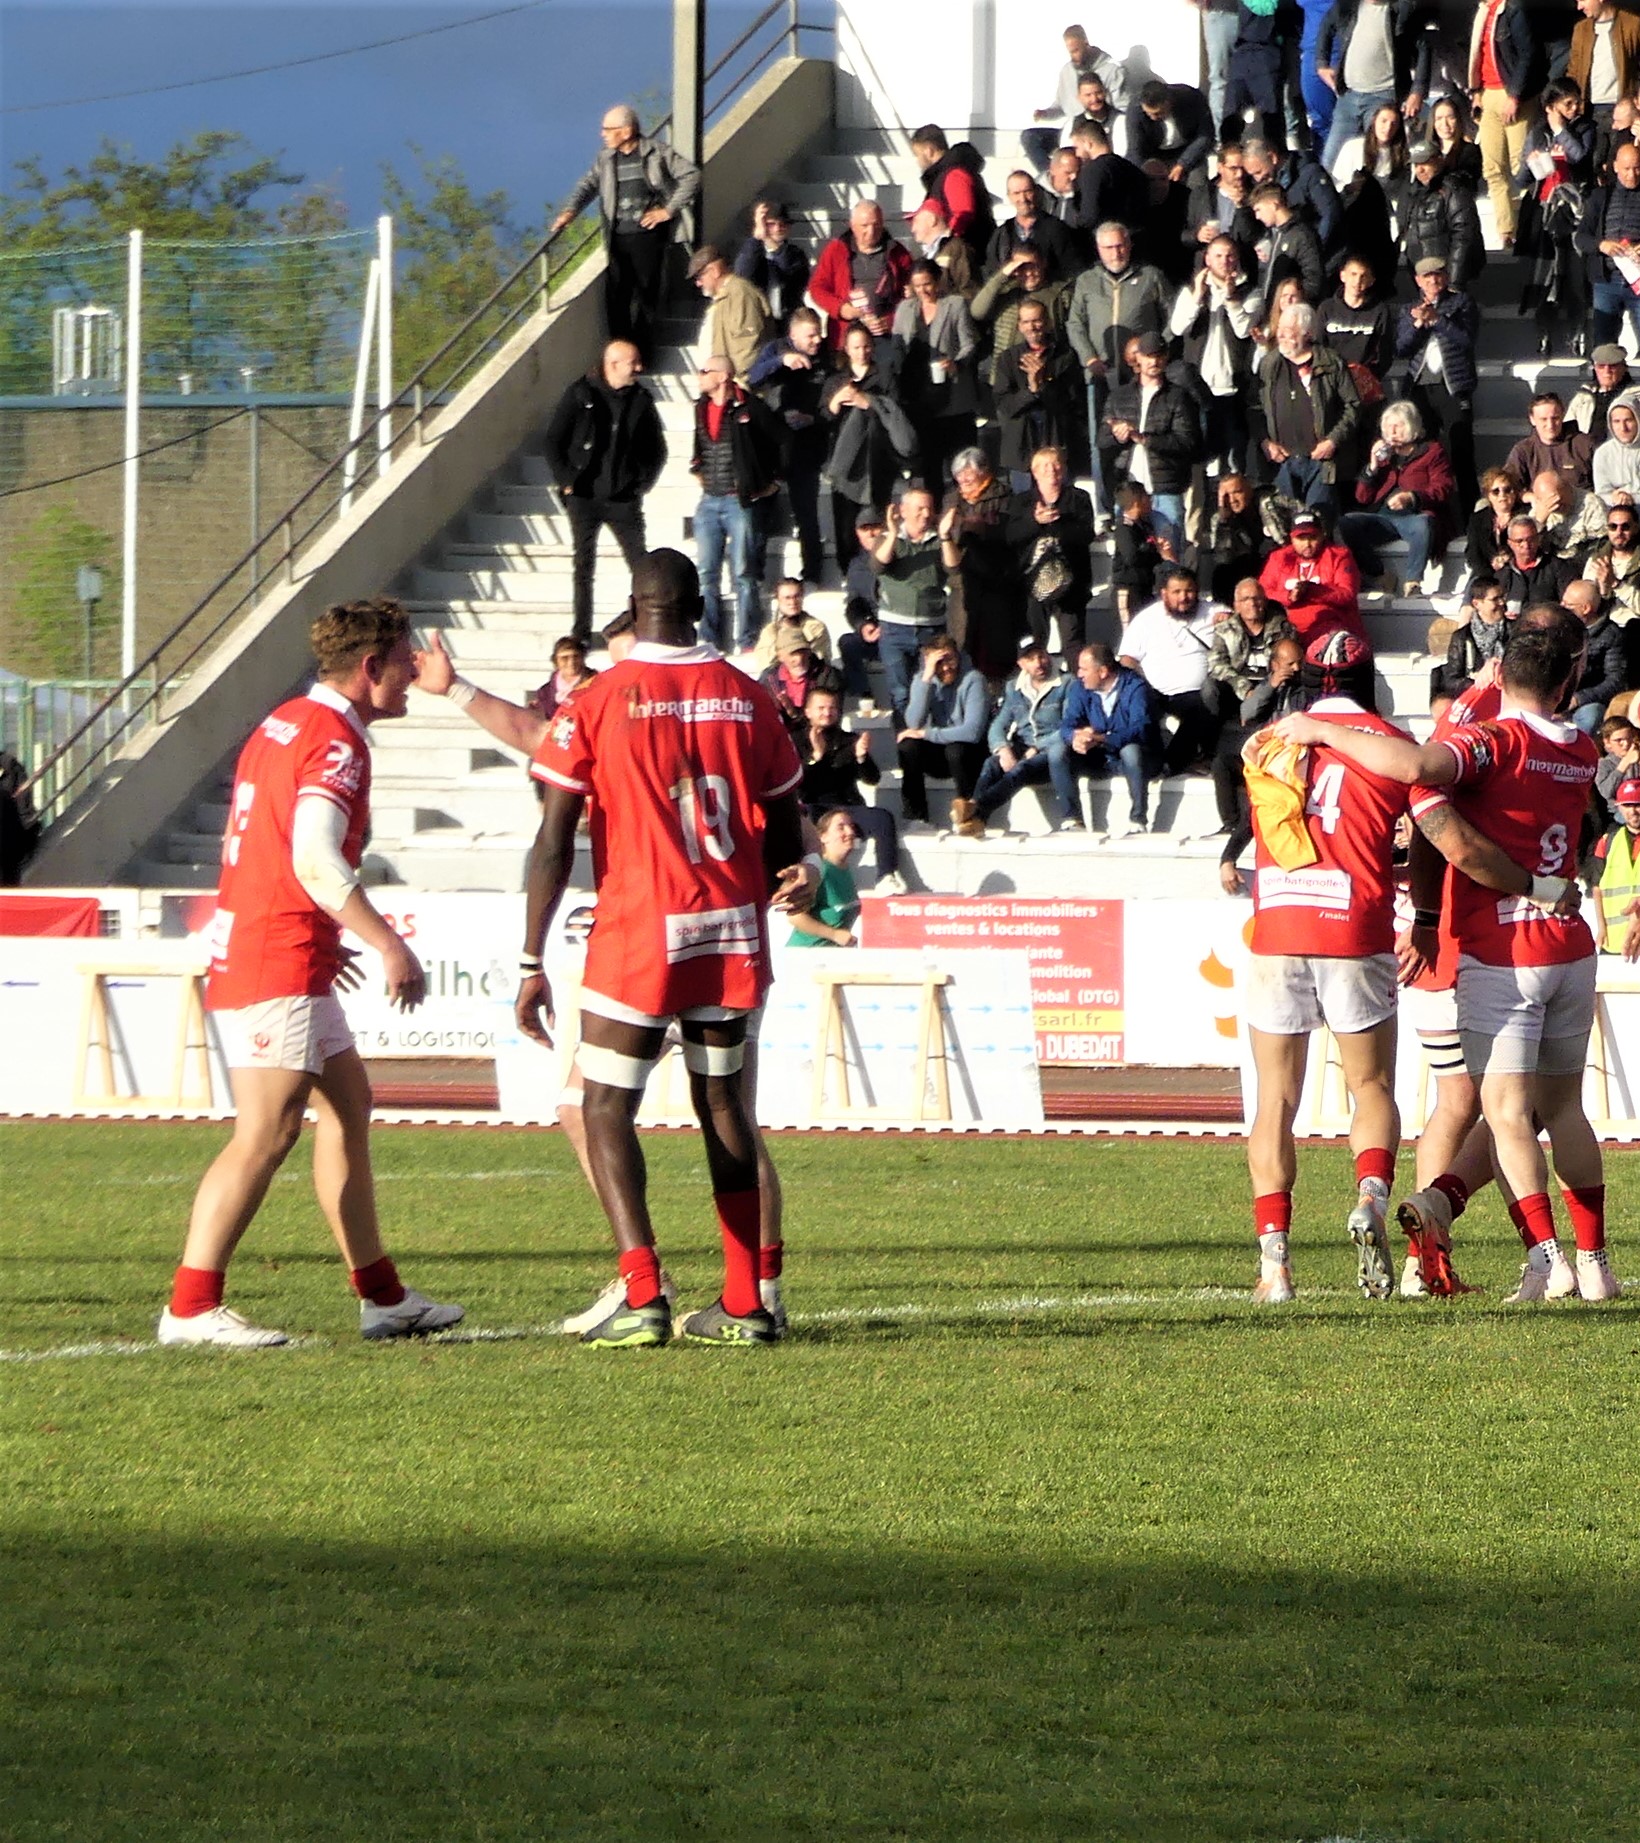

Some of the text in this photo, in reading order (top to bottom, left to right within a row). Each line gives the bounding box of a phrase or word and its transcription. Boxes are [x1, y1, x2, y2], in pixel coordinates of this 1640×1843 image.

[1306, 764, 1345, 834] 4
[669, 774, 735, 864] 19
[886, 902, 1098, 919] Tous diagnostics immobiliers
[924, 921, 1061, 937] ventes & locations
[1077, 989, 1120, 1006] (DTG)
[1033, 1012, 1102, 1027] sarl.fr
[377, 1031, 390, 1047] &
[1045, 1034, 1121, 1060] DUBEDAT
